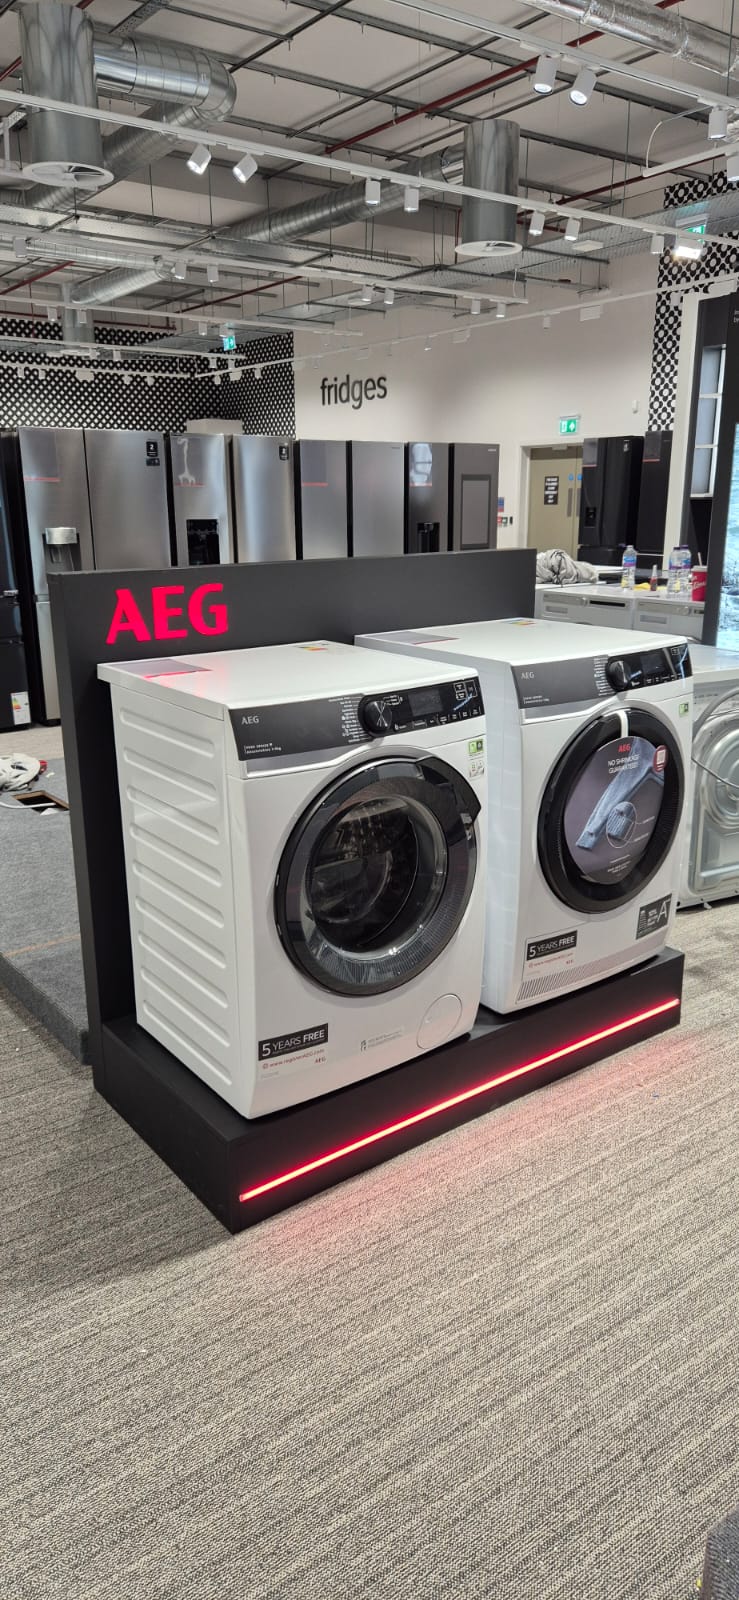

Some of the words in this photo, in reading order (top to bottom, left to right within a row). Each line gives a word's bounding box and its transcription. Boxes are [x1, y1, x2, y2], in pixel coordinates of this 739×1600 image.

[320, 374, 387, 409] fridges
[105, 582, 229, 645] AEG
[520, 671, 535, 680] AEG
[241, 715, 260, 725] AEG
[618, 743, 631, 753] AEG
[607, 759, 616, 767] NO
[529, 945, 537, 958] 5
[537, 940, 558, 953] YEARS
[558, 935, 575, 947] FREE
[262, 1042, 271, 1057] 5
[272, 1036, 302, 1051] YEARS
[303, 1030, 325, 1043] FREE
